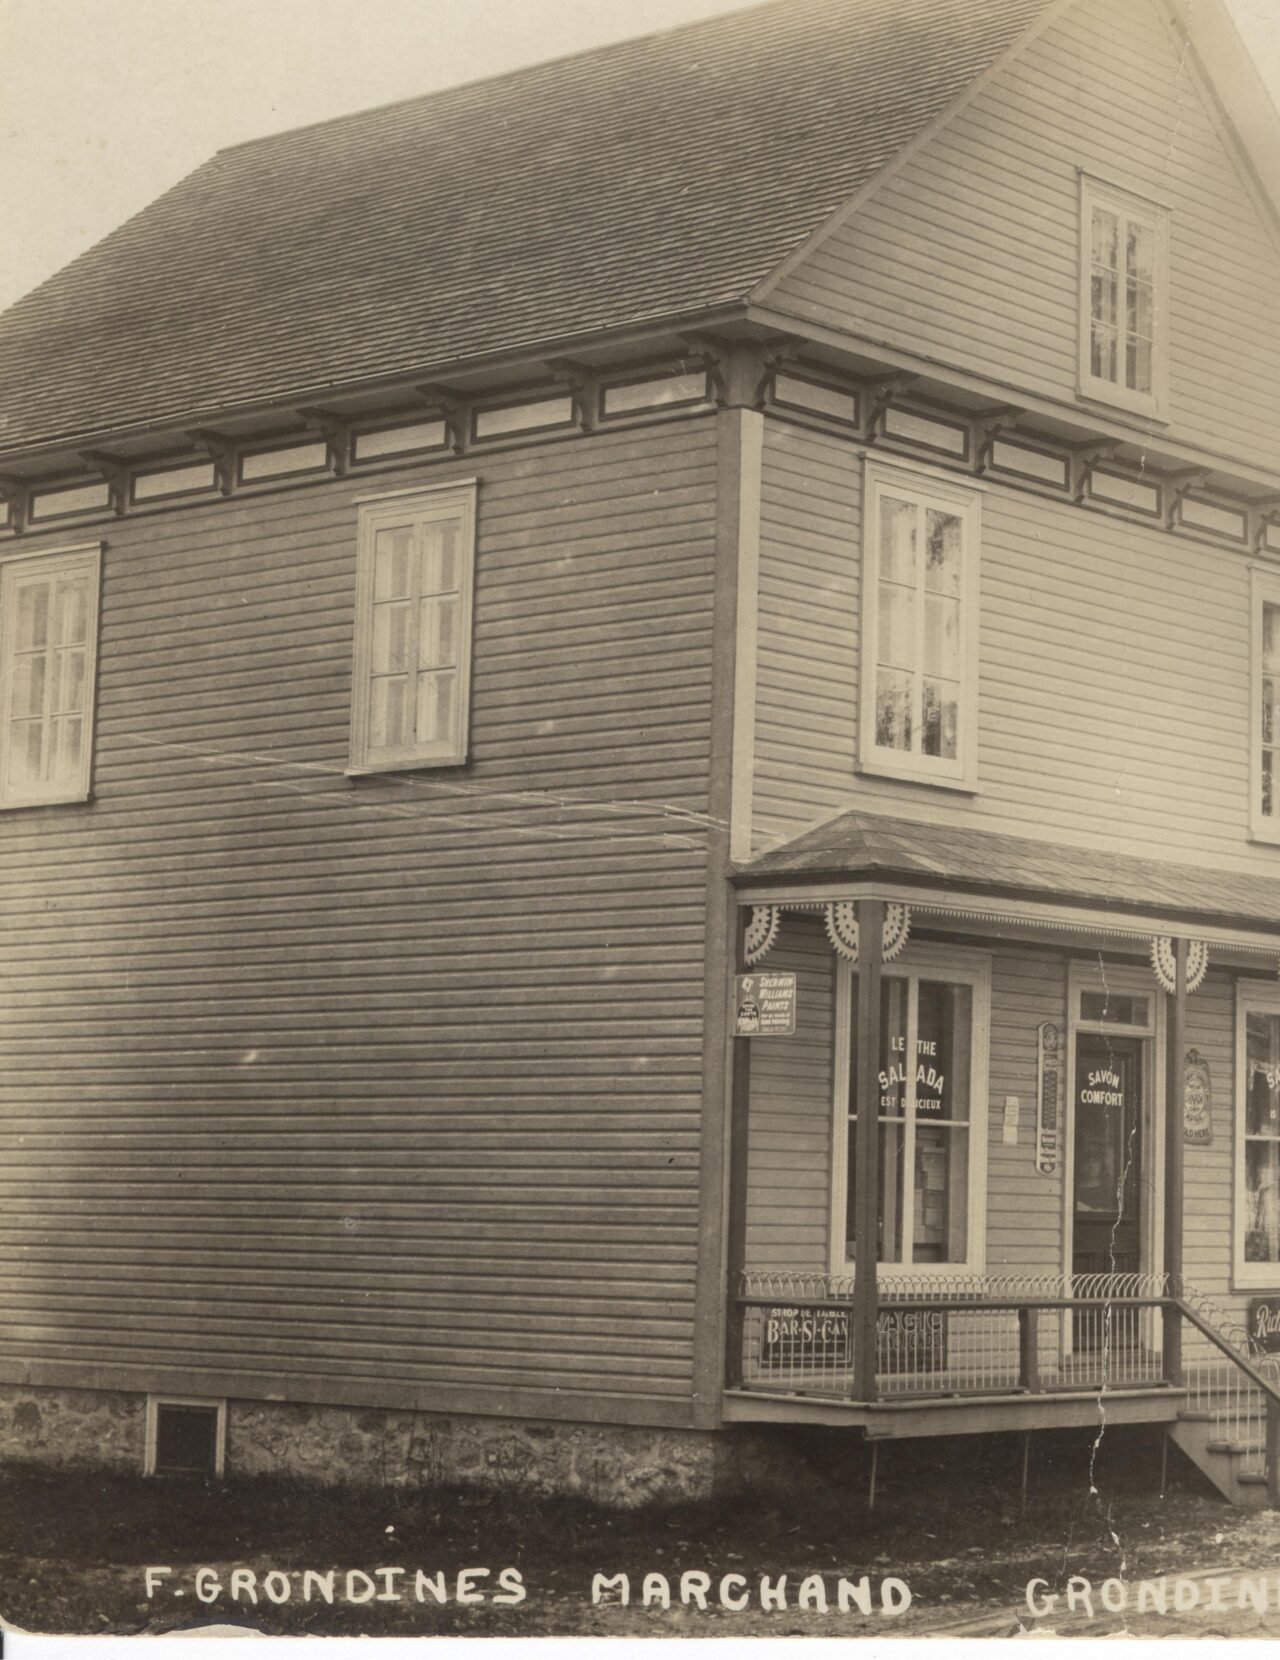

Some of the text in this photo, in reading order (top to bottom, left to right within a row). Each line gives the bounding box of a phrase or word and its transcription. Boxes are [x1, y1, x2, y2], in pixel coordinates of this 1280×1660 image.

[892, 1036, 936, 1056] LE THE
[878, 1062, 944, 1095] SALADA
[1088, 1070, 1119, 1089] SAVON
[881, 1096, 896, 1108] EST
[1081, 1089, 1123, 1106] COMFORT
